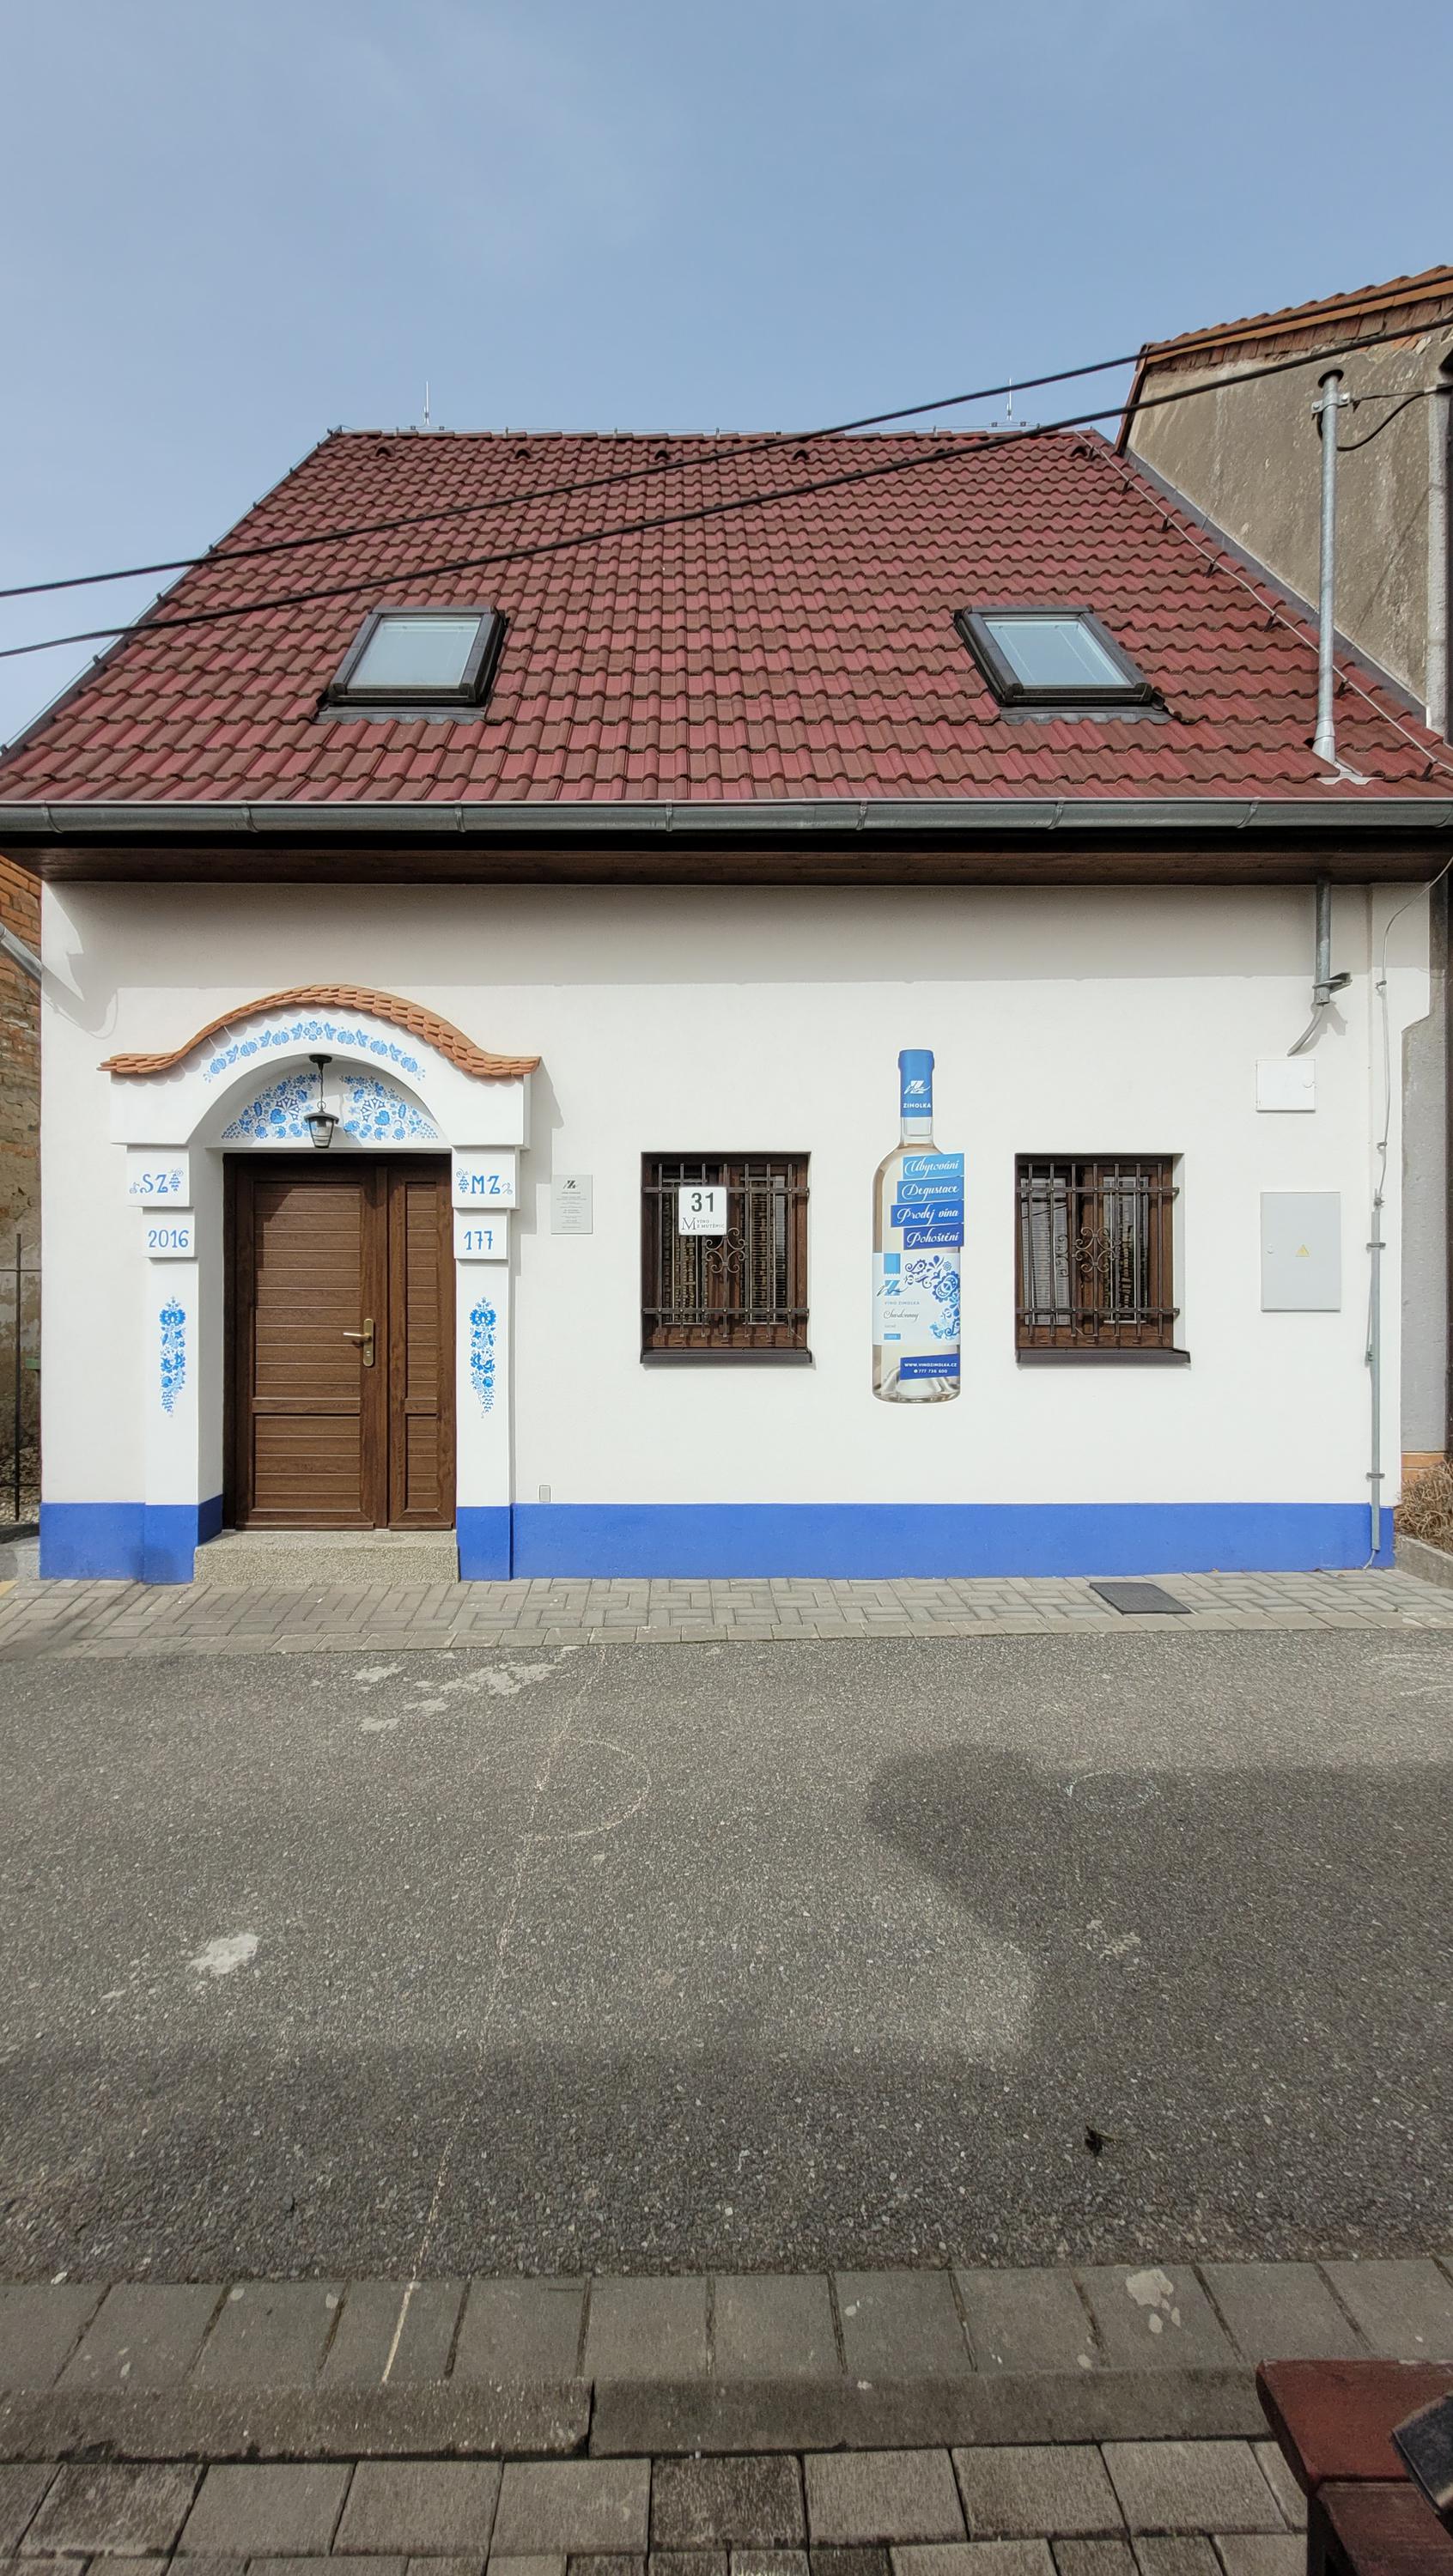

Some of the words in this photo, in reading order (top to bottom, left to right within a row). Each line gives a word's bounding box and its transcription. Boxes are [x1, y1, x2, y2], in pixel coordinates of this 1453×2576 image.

[904, 1156, 959, 1178] Ubytování
[690, 1192, 714, 1212] 31
[901, 1182, 960, 1202] Degustace
[681, 1217, 696, 1230] M
[897, 1203, 935, 1226] Prodej
[938, 1207, 959, 1218] vína
[148, 1229, 190, 1248] 2016
[463, 1230, 494, 1250] 177
[906, 1227, 960, 1248] Pohoštění
